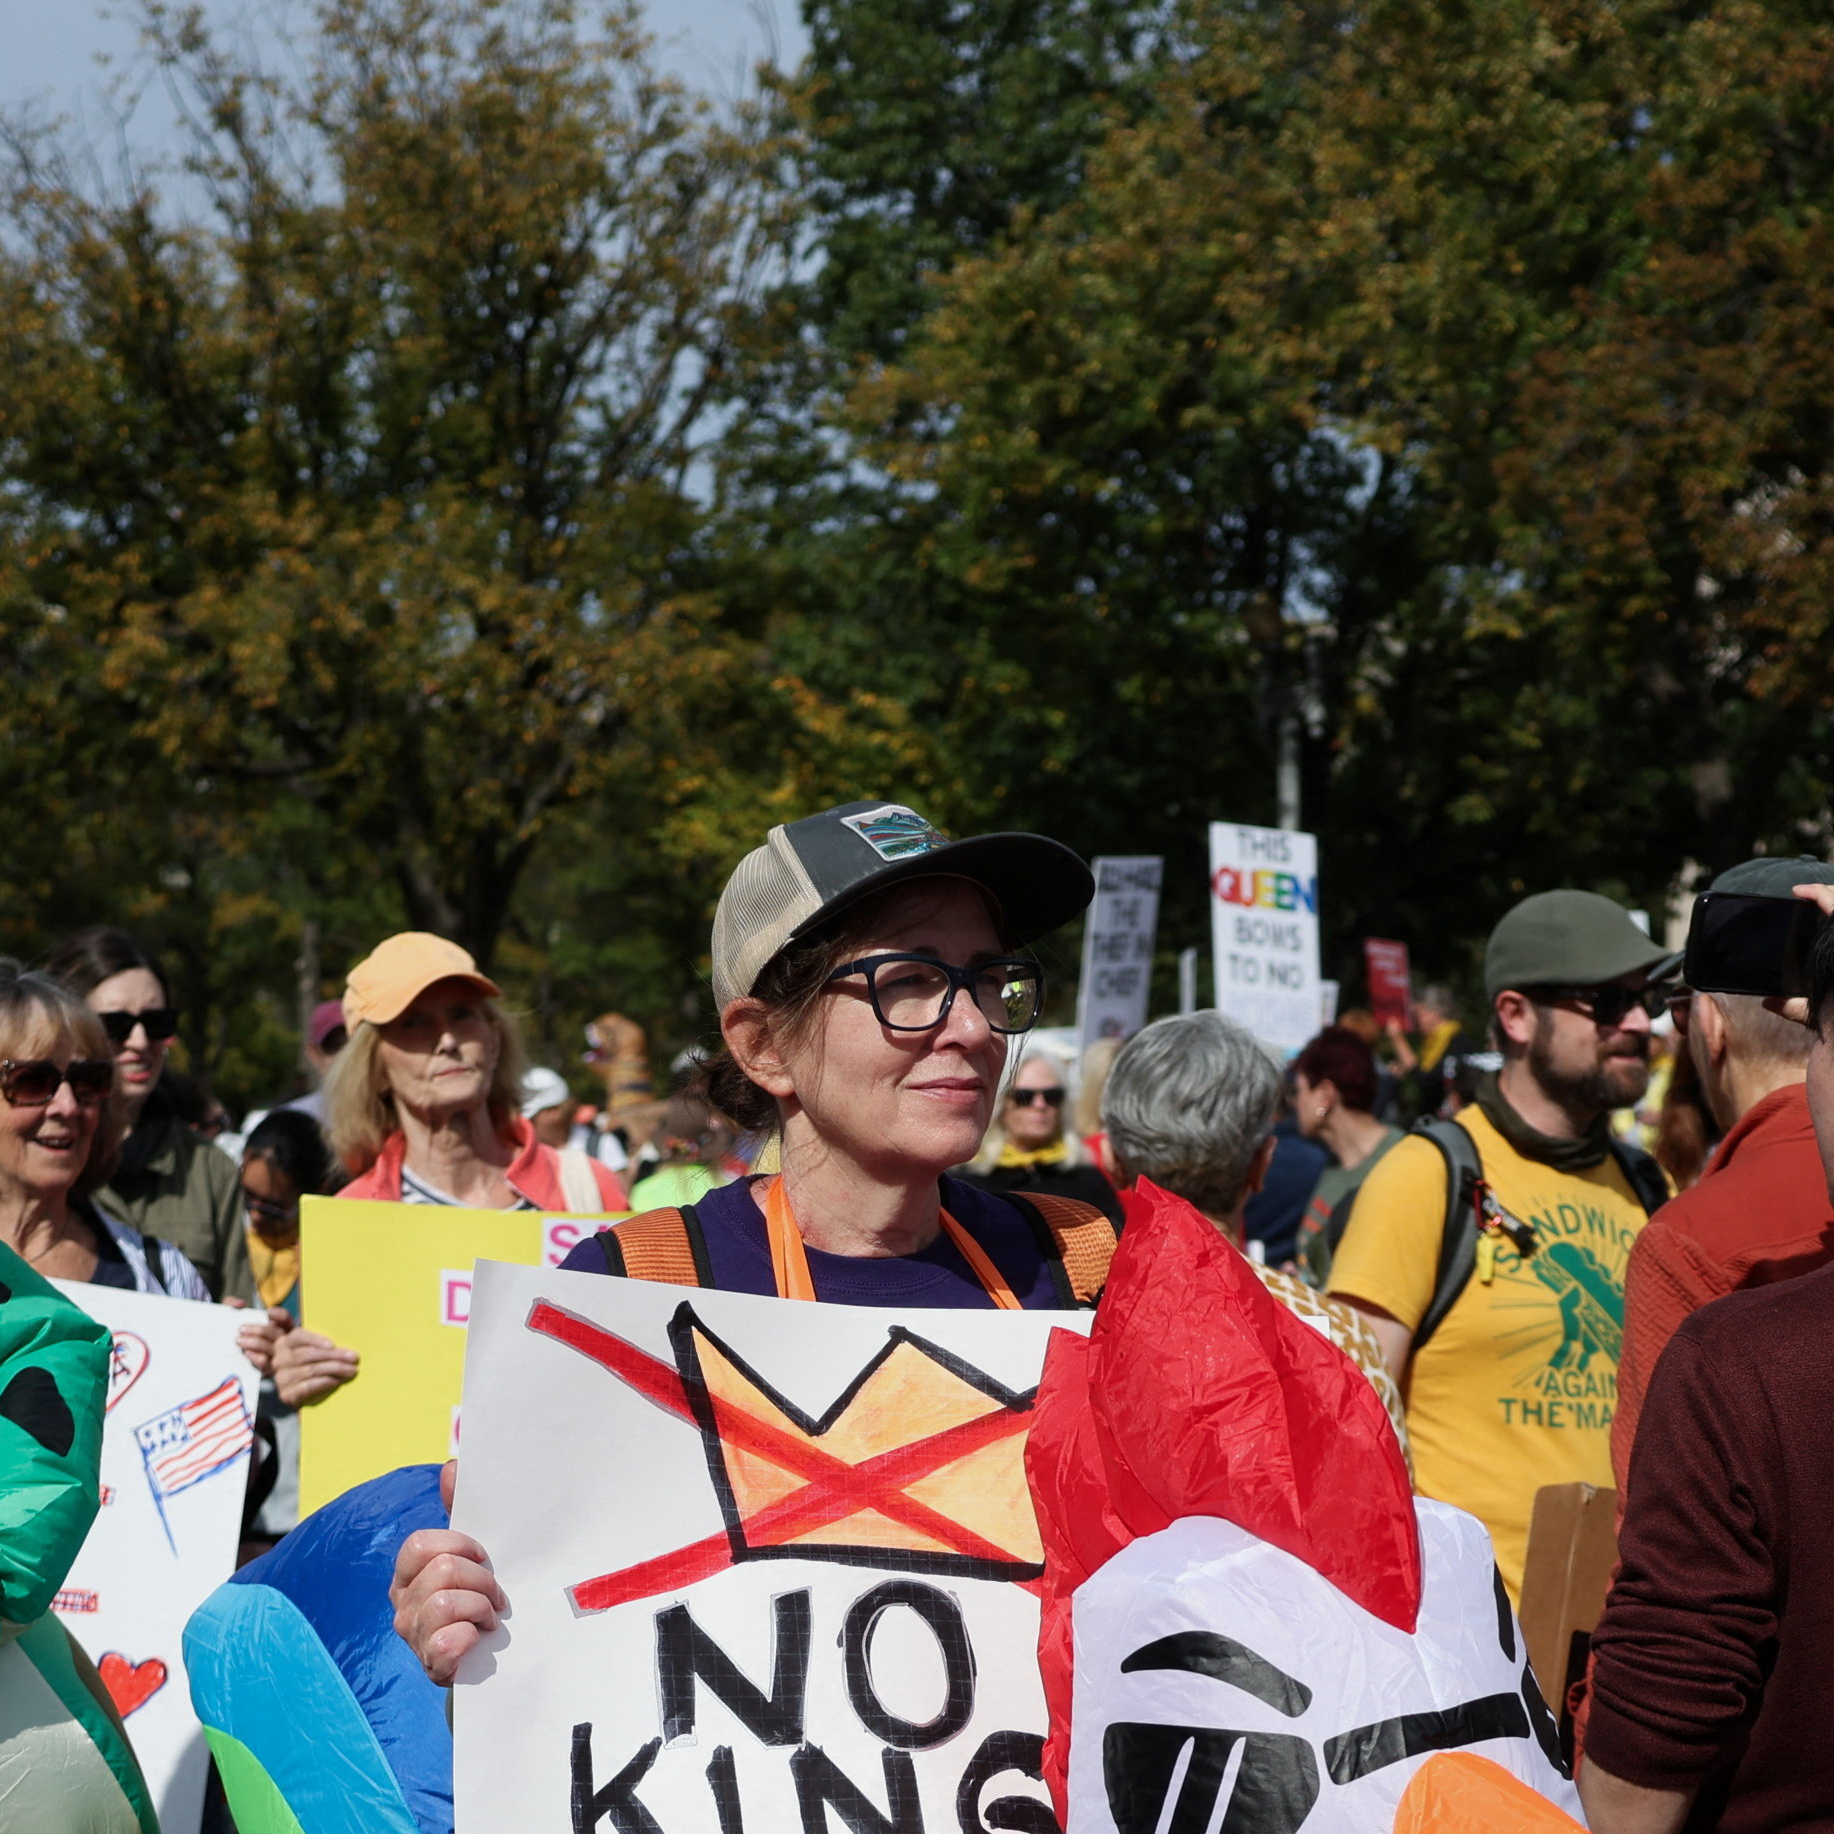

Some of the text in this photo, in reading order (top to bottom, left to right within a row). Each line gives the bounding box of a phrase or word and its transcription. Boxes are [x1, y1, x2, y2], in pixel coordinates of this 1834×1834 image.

[1236, 831, 1292, 863] THIS
[1211, 867, 1319, 914] QUEEN
[1234, 916, 1302, 954] BOWS
[1228, 953, 1304, 990] TO NO
[1497, 1397, 1565, 1428] THE
[652, 1577, 978, 1752] NO
